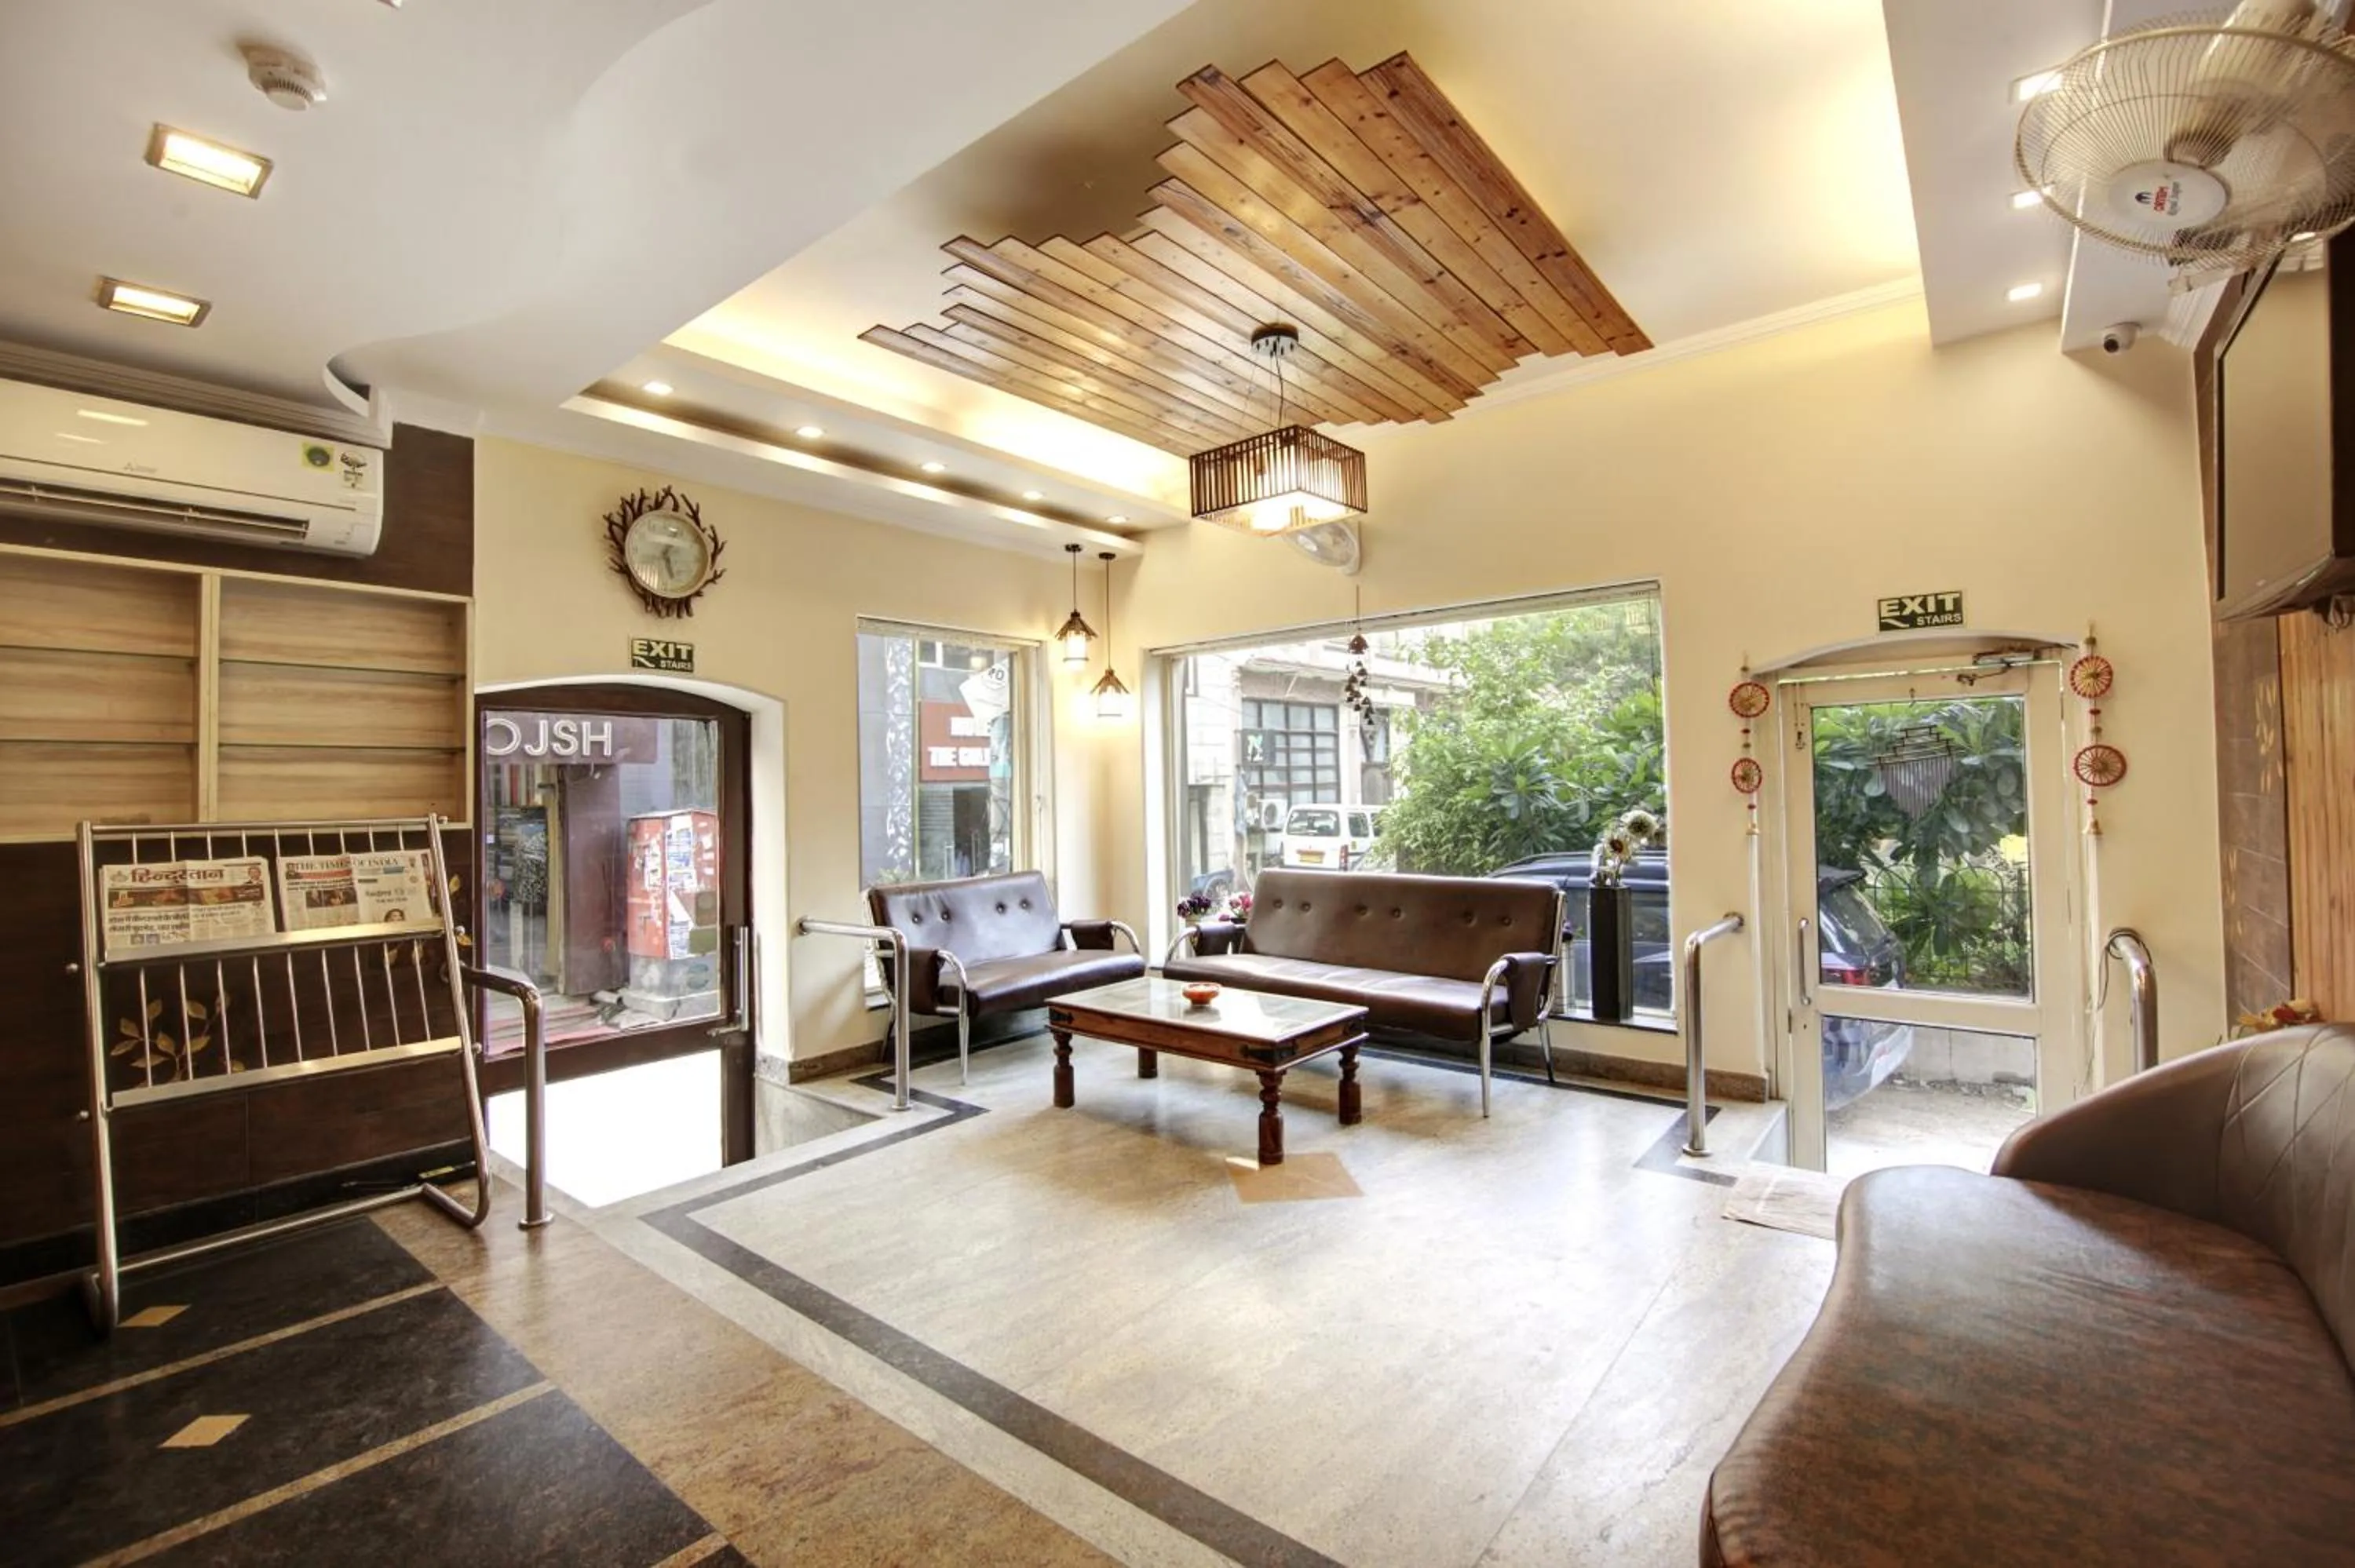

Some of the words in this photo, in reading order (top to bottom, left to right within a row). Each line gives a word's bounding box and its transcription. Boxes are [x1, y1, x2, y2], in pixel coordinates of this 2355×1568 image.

[1880, 593, 1961, 618] EXIT
[1916, 613, 1962, 625] STAIRS
[633, 640, 692, 660] EXIT
[659, 660, 692, 670] STAIRS
